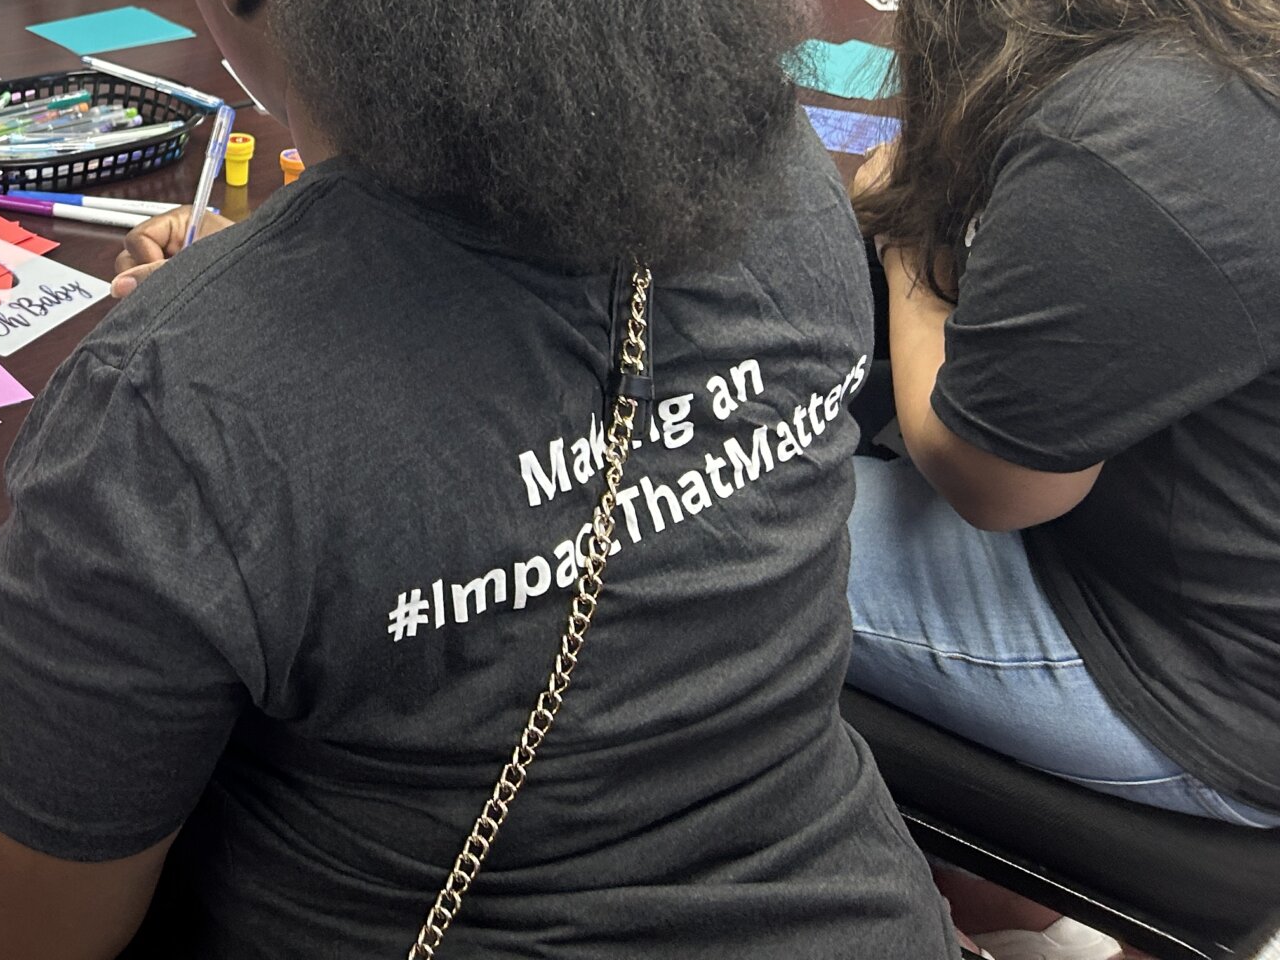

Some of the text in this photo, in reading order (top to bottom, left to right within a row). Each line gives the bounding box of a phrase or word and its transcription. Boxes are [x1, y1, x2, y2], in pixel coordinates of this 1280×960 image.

[8, 281, 93, 316] Baby
[518, 358, 764, 507] Makg an
